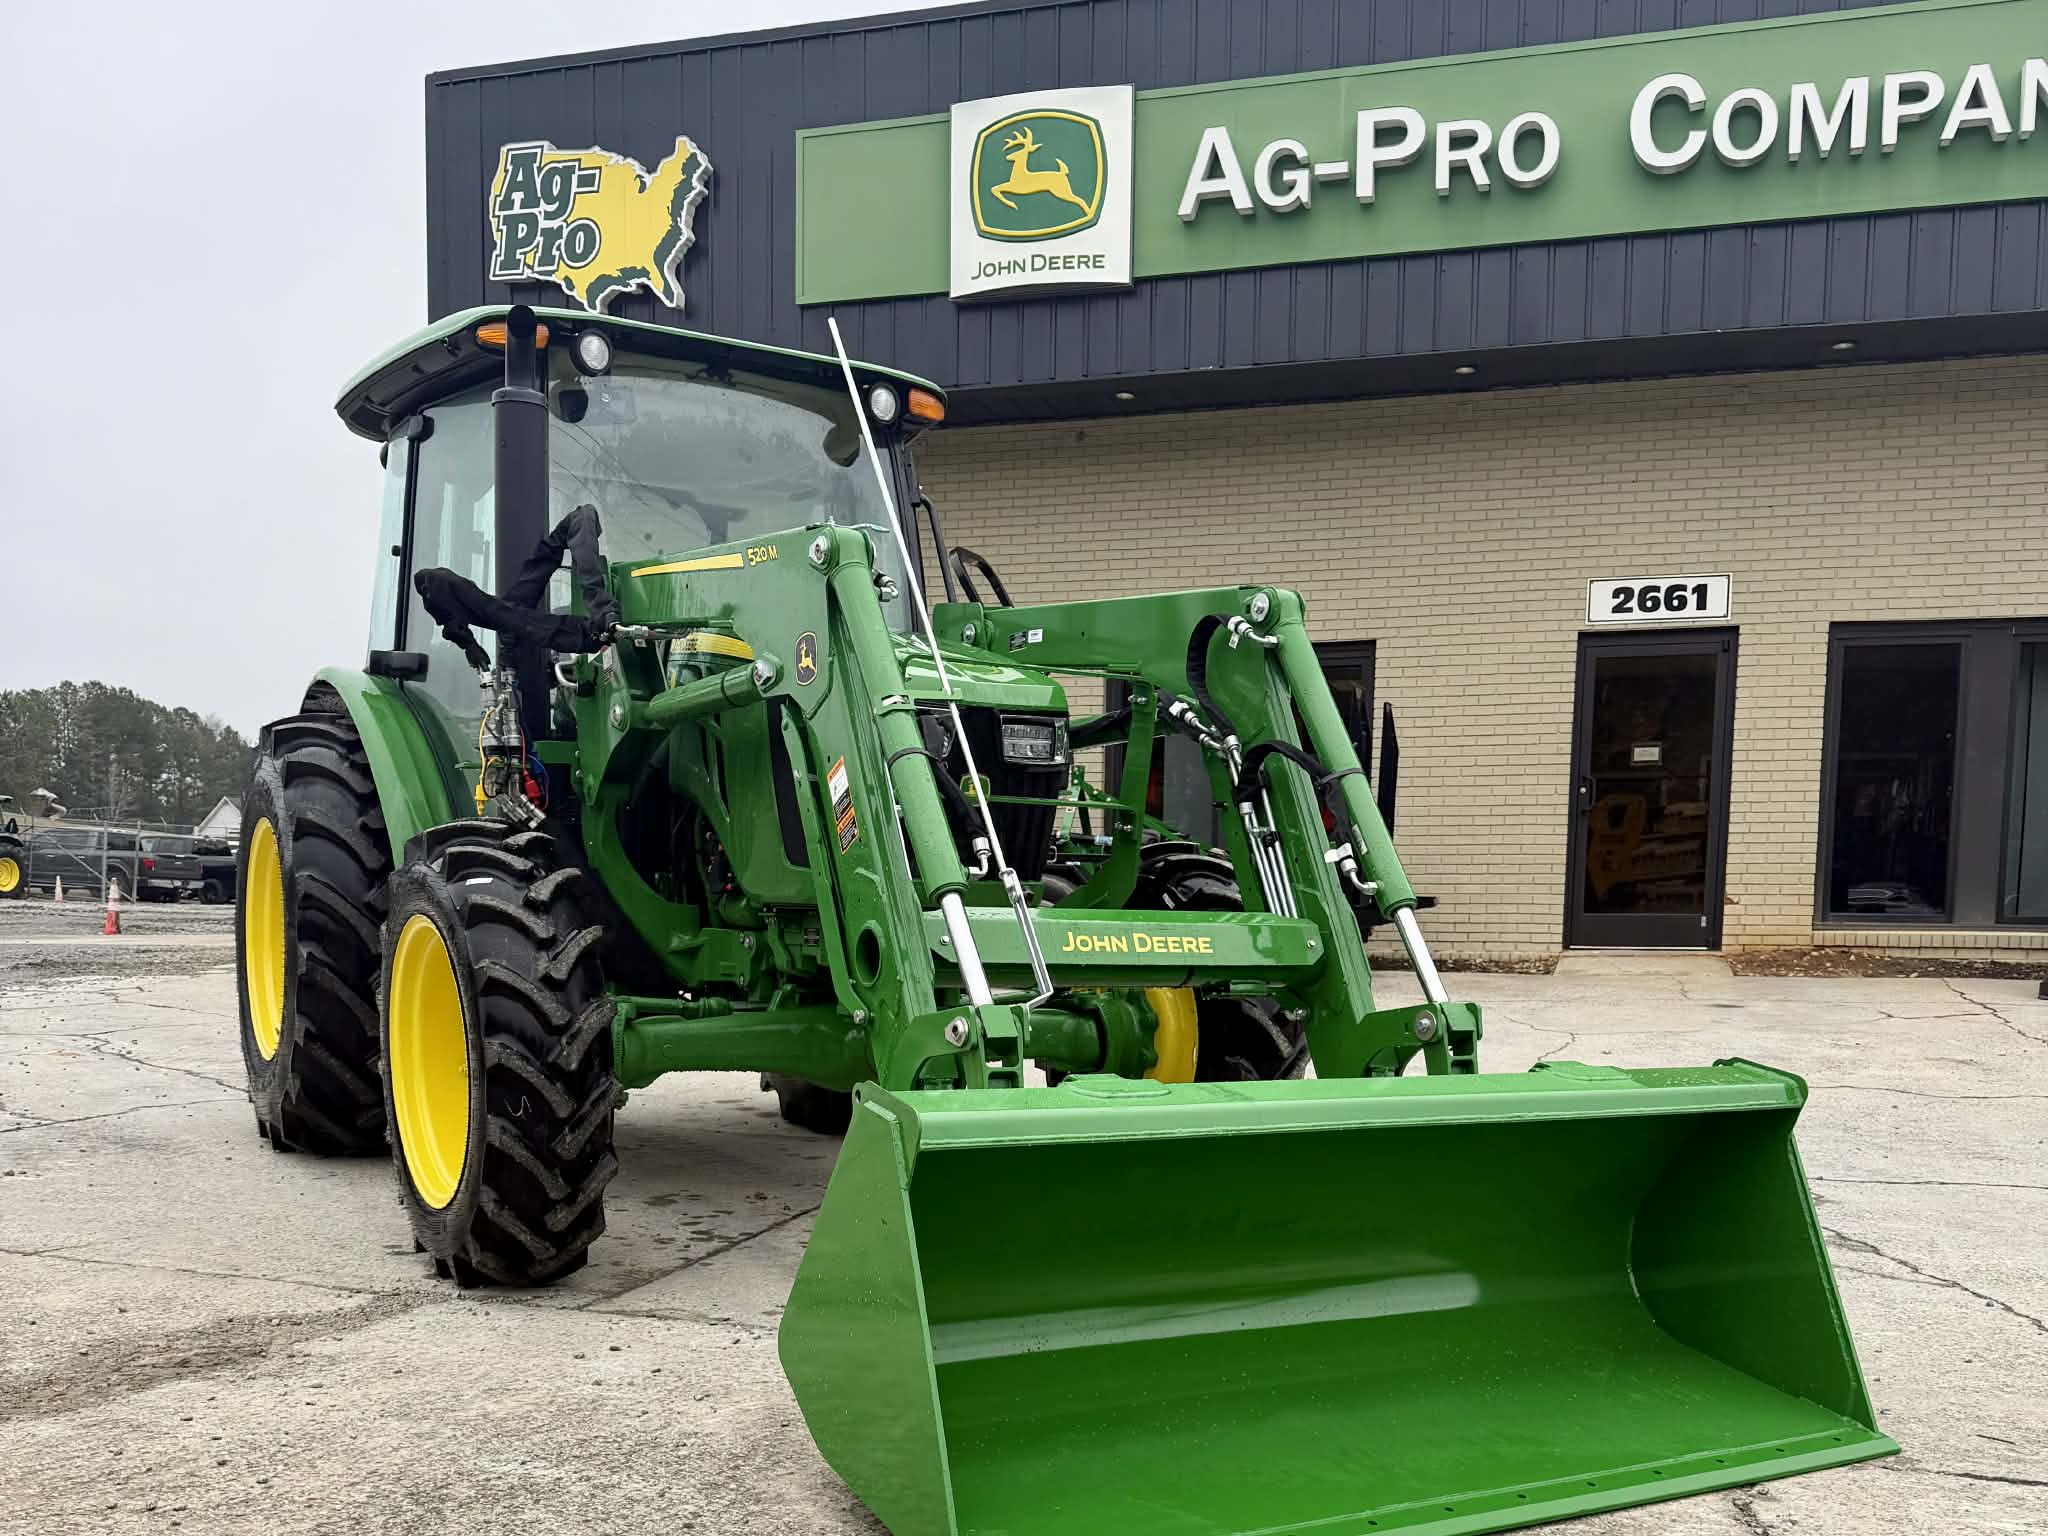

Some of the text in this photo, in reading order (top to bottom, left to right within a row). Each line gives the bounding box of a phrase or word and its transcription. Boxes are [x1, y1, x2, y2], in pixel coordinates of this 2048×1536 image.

[494, 146, 600, 222] Ag-
[1177, 105, 1562, 222] AG-PRO
[493, 212, 600, 276] Pro
[970, 253, 1106, 280] JOHN DEERE
[1611, 583, 1708, 614] 2661
[1062, 931, 1214, 954] JOHN DEERE
